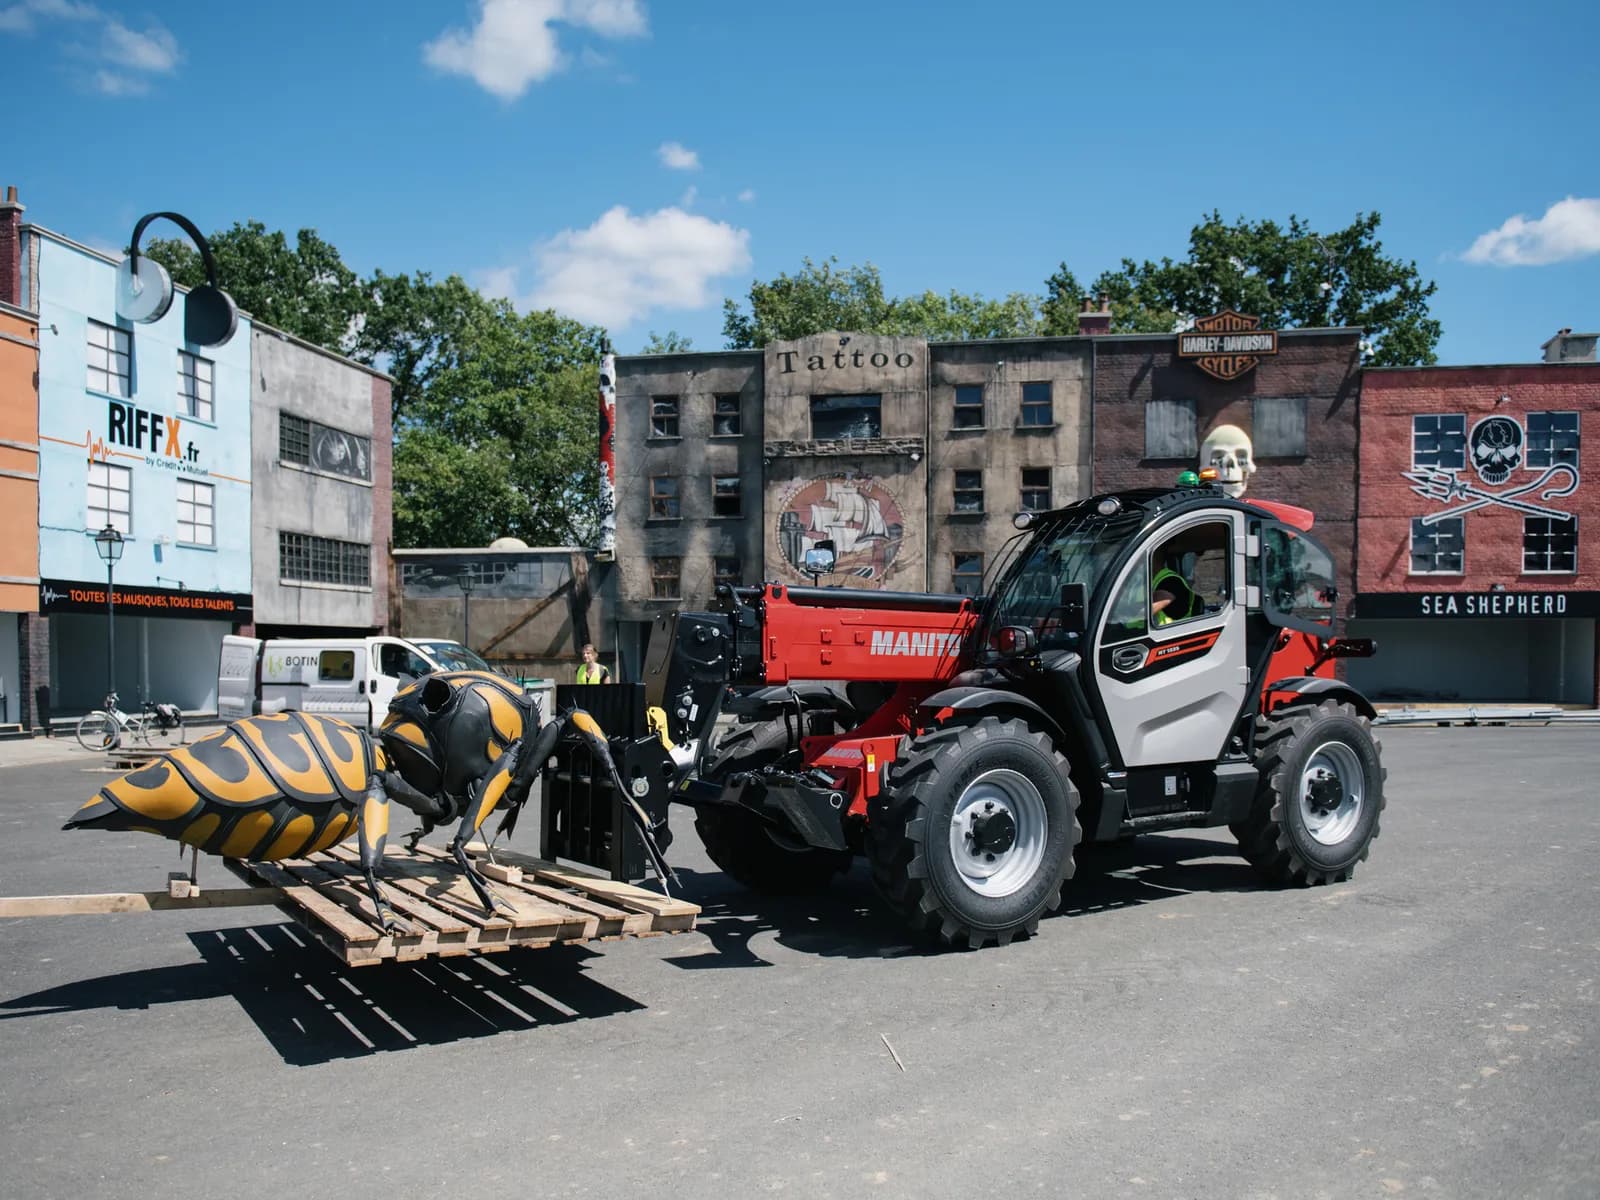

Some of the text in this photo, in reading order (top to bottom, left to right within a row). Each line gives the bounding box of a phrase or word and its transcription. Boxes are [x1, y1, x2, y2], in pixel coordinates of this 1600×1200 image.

[1204, 314, 1253, 331] MOTOR
[1183, 334, 1273, 353] HARLEY-DAVIDSON
[776, 349, 914, 374] Tattoo
[1203, 355, 1253, 376] CYCLES
[186, 464, 209, 477] Mutuel
[69, 589, 105, 603] TOUTES
[123, 594, 169, 608] MUSIQUES,
[169, 596, 191, 609] TOUS
[191, 598, 204, 609] LES
[204, 599, 235, 611] TALENTS
[1421, 594, 1566, 614] SEA SHEPHERD
[870, 630, 962, 657] MANITO
[285, 655, 319, 666] BOTIN
